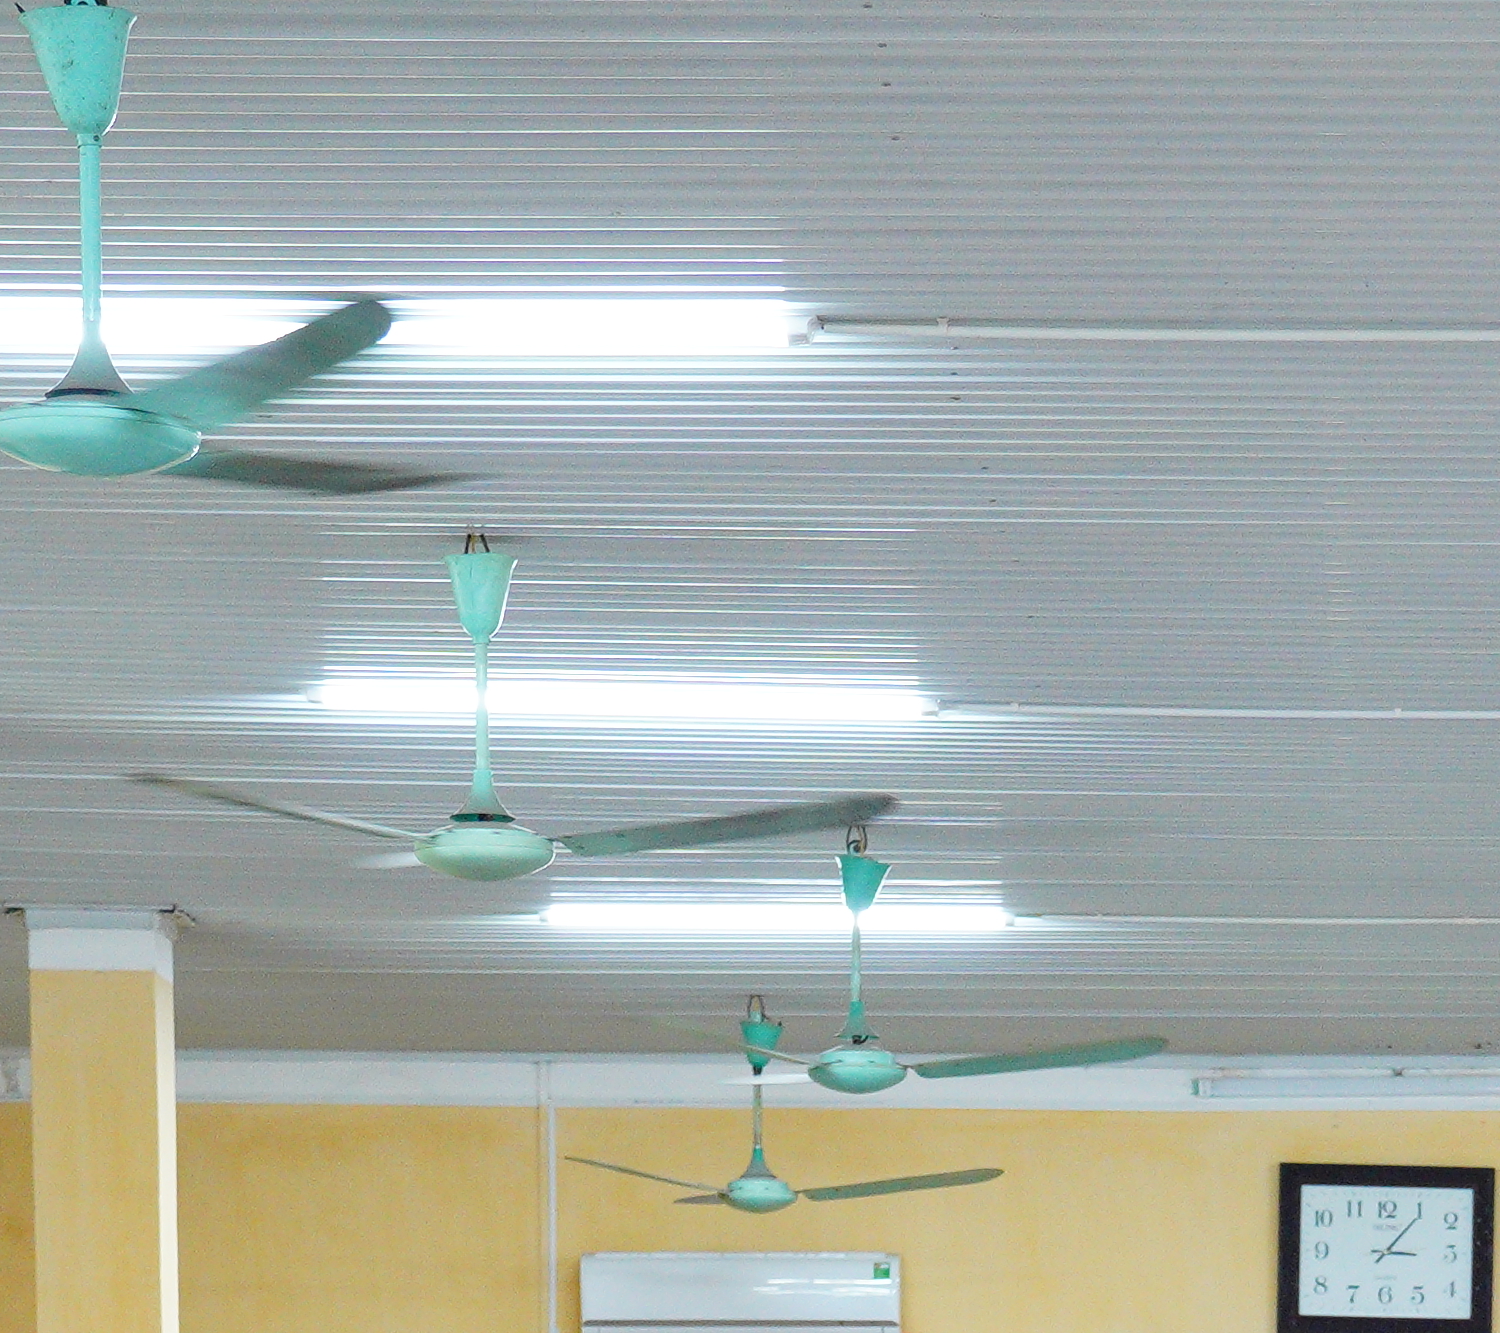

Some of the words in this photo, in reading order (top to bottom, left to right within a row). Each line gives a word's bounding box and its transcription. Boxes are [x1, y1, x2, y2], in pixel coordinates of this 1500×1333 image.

[1314, 1209, 1333, 1228] 10
[1346, 1200, 1363, 1218] 11
[1377, 1200, 1398, 1219] 12
[1416, 1202, 1423, 1220] 1
[1314, 1241, 1330, 1260] 9
[1442, 1244, 1458, 1264] 3
[1313, 1275, 1328, 1295] 8
[1345, 1285, 1360, 1304] 7
[1443, 1280, 1456, 1298] 4
[1377, 1286, 1393, 1305] 6
[1411, 1285, 1425, 1305] 5
